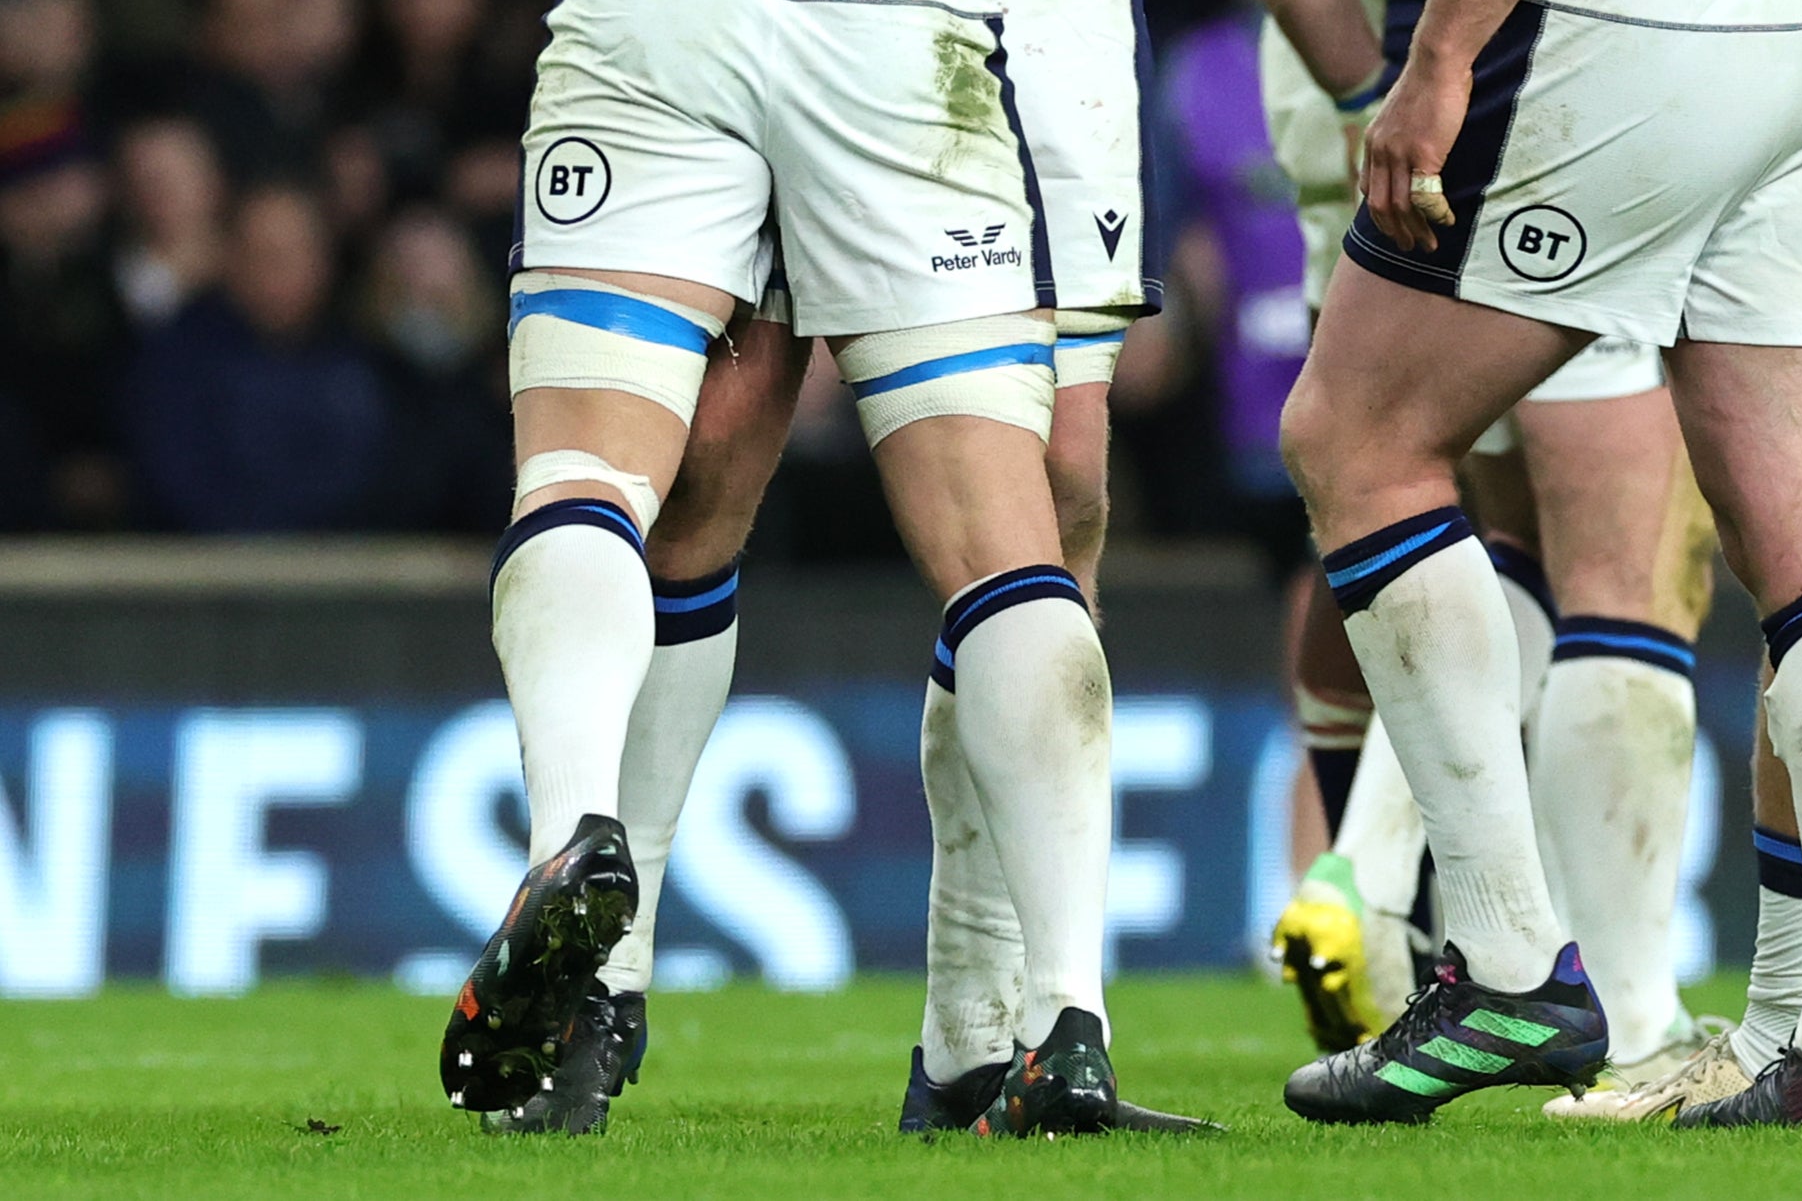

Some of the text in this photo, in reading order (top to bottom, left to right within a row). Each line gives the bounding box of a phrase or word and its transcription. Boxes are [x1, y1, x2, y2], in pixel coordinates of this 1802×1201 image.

[549, 165, 593, 197] BT
[1516, 224, 1570, 261] BT
[931, 246, 1022, 273] Peter Vardy
